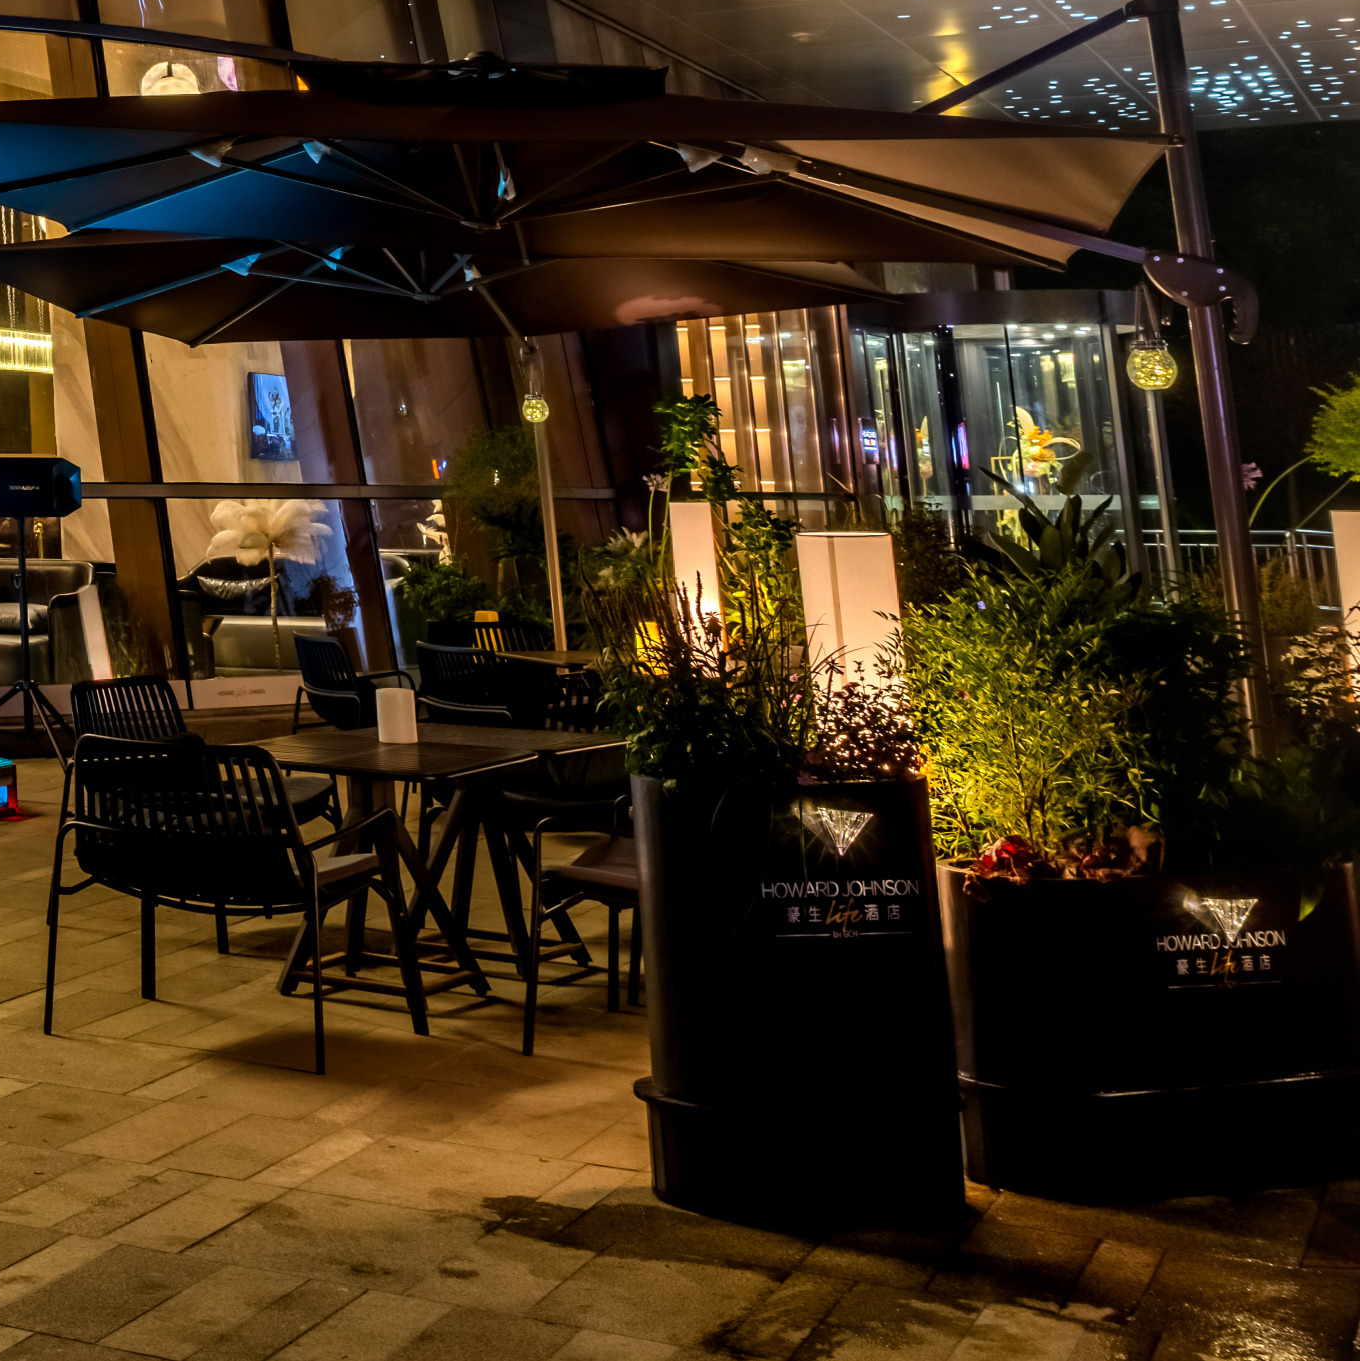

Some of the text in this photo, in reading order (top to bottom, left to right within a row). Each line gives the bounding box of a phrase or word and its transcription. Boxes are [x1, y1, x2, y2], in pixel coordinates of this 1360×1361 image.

[761, 879, 919, 899] HOWARD JOHNSON
[864, 903, 901, 921] 酒店
[1156, 933, 1220, 952] HOWARD
